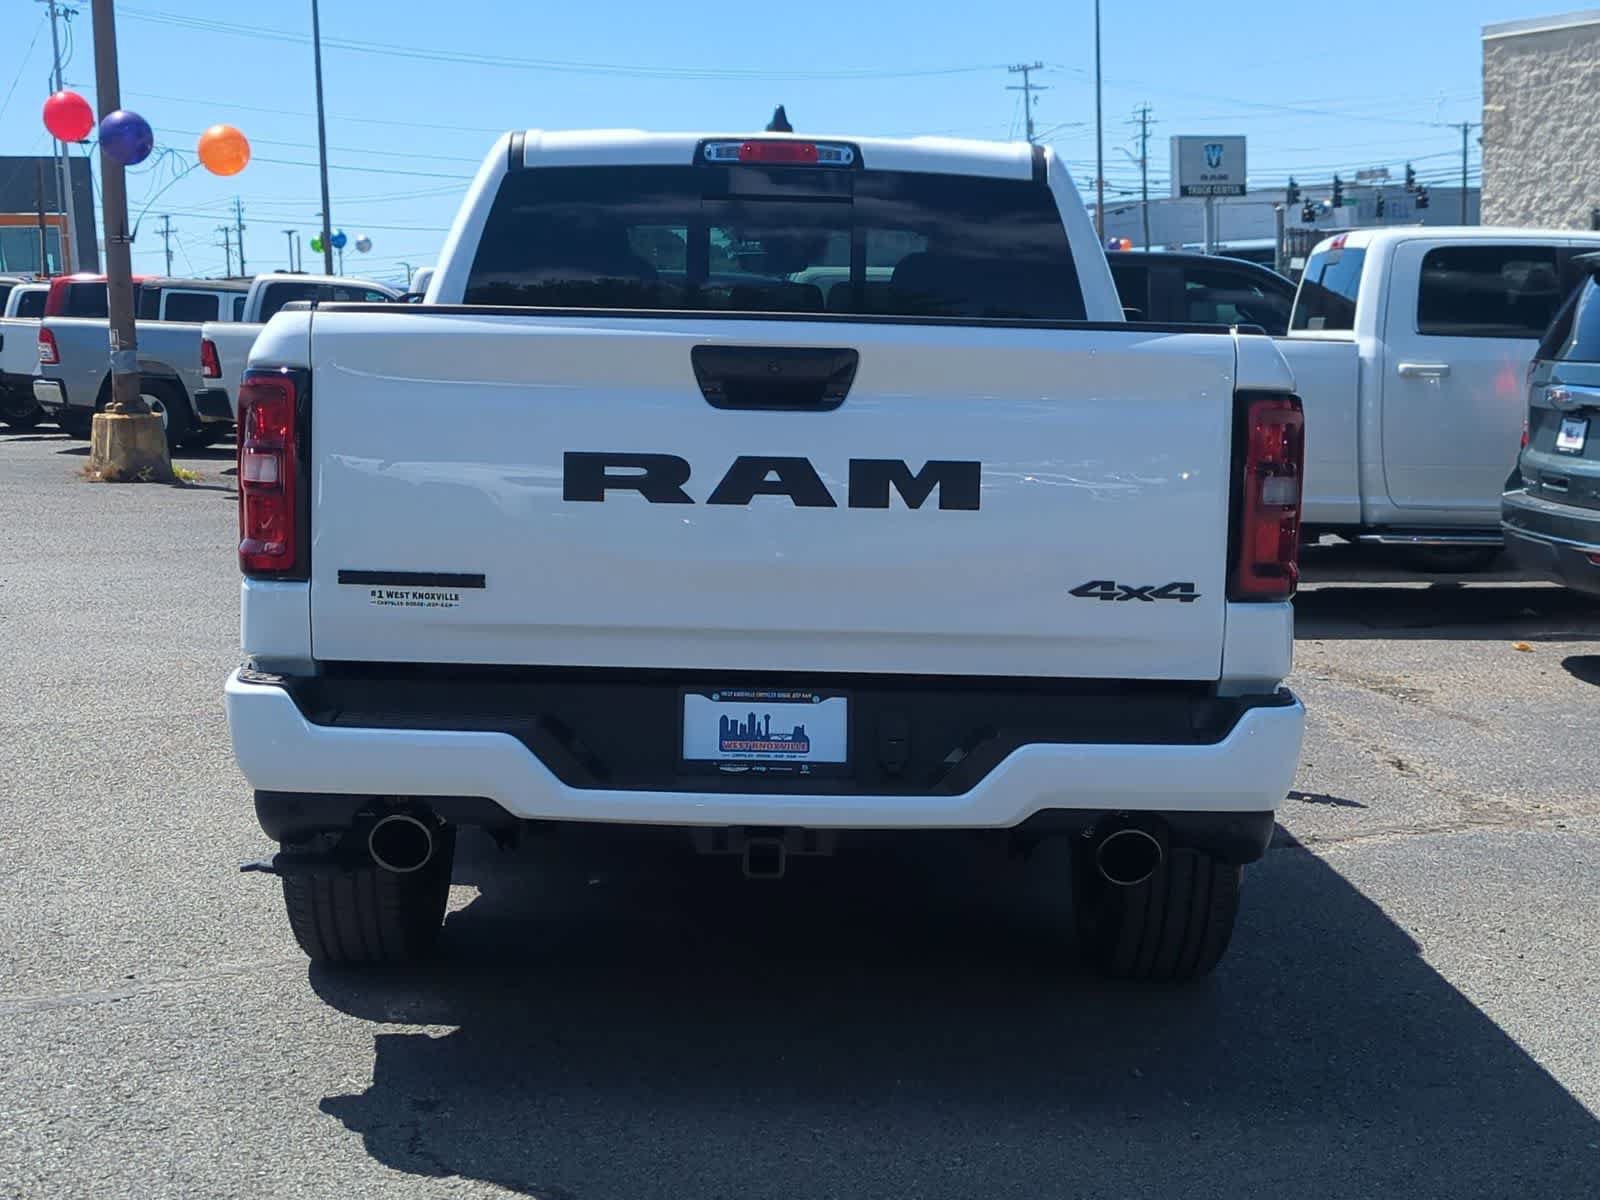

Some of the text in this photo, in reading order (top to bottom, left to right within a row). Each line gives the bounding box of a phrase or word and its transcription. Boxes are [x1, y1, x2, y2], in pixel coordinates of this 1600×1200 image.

[563, 451, 982, 511] RAM
[386, 590, 410, 600] WEST
[412, 591, 460, 601] KNOXVILLE
[1068, 580, 1202, 602] 4x4
